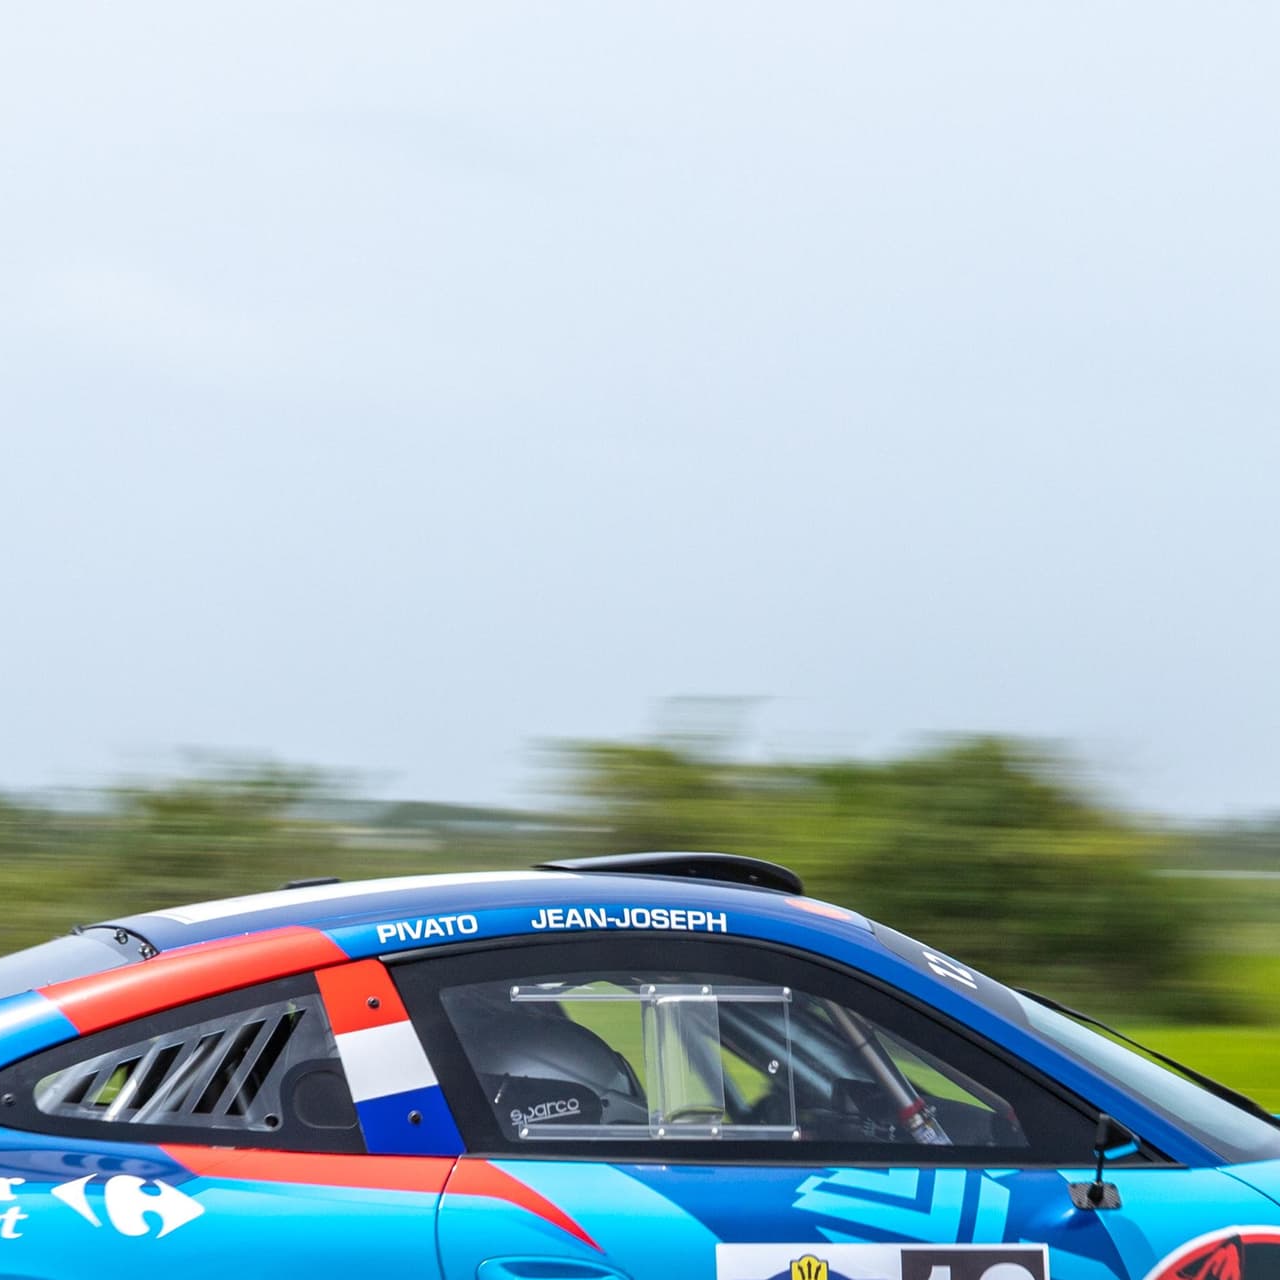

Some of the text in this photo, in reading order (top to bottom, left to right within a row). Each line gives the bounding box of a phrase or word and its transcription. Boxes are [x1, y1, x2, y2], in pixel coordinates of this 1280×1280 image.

[376, 907, 728, 945] PIVATO JEAN-JOSEPH
[510, 1097, 580, 1125] sparco
